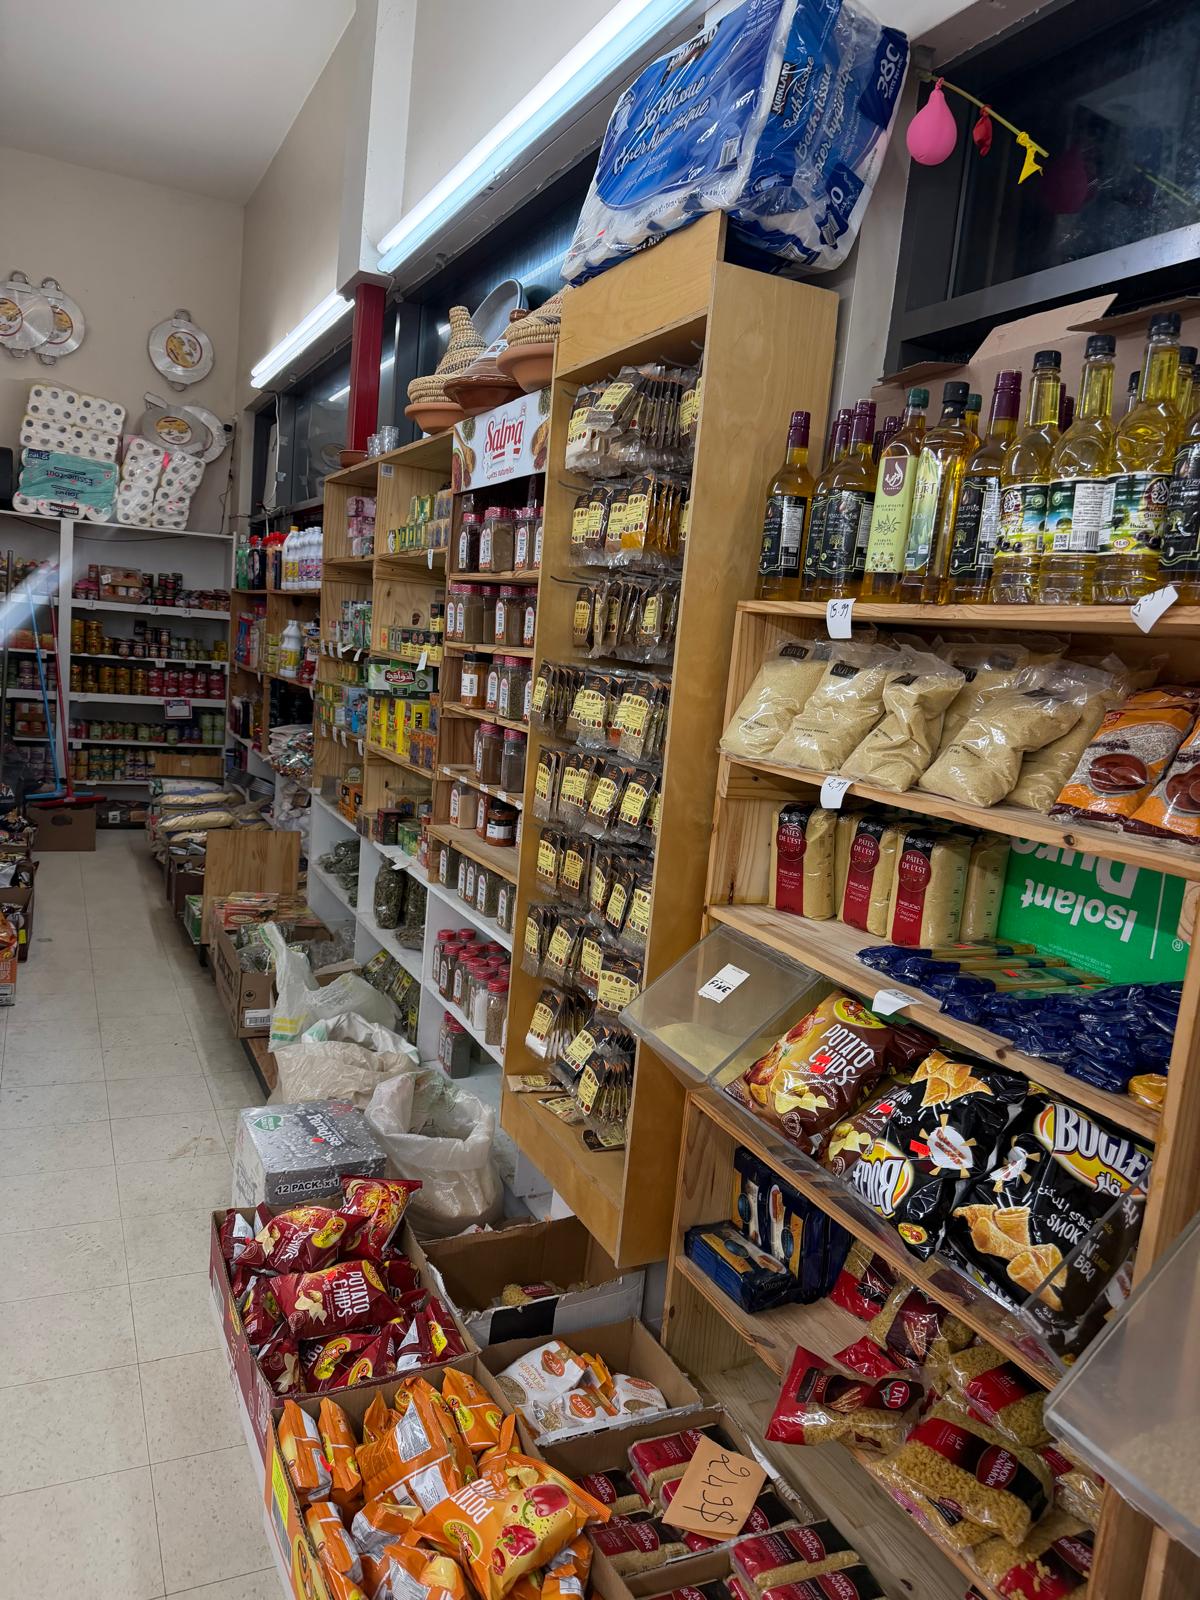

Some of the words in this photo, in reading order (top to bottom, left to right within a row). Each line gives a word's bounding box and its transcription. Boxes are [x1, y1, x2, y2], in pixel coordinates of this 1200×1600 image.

[772, 62, 794, 112] KIRKLAND
[783, 98, 803, 129] Bath
[794, 57, 815, 99] Tissue
[485, 418, 524, 453] Salma
[778, 835, 788, 844] DE
[787, 836, 803, 846] L'EST
[853, 844, 863, 853] DE
[862, 846, 877, 857] L'EST
[901, 861, 912, 871] DE
[910, 863, 928, 876] L'EST
[1020, 878, 1139, 944] Isolant
[819, 1023, 876, 1069] POTATO
[275, 1184, 291, 1196] 12
[291, 1181, 324, 1194] PACK.
[1073, 1255, 1096, 1283] BBQ
[331, 1279, 354, 1319] CHIPS
[346, 1270, 370, 1315] POTATO
[889, 1385, 906, 1406] TAT
[985, 1449, 1010, 1487] BENAMOR
[996, 1458, 1016, 1482] AMOR
